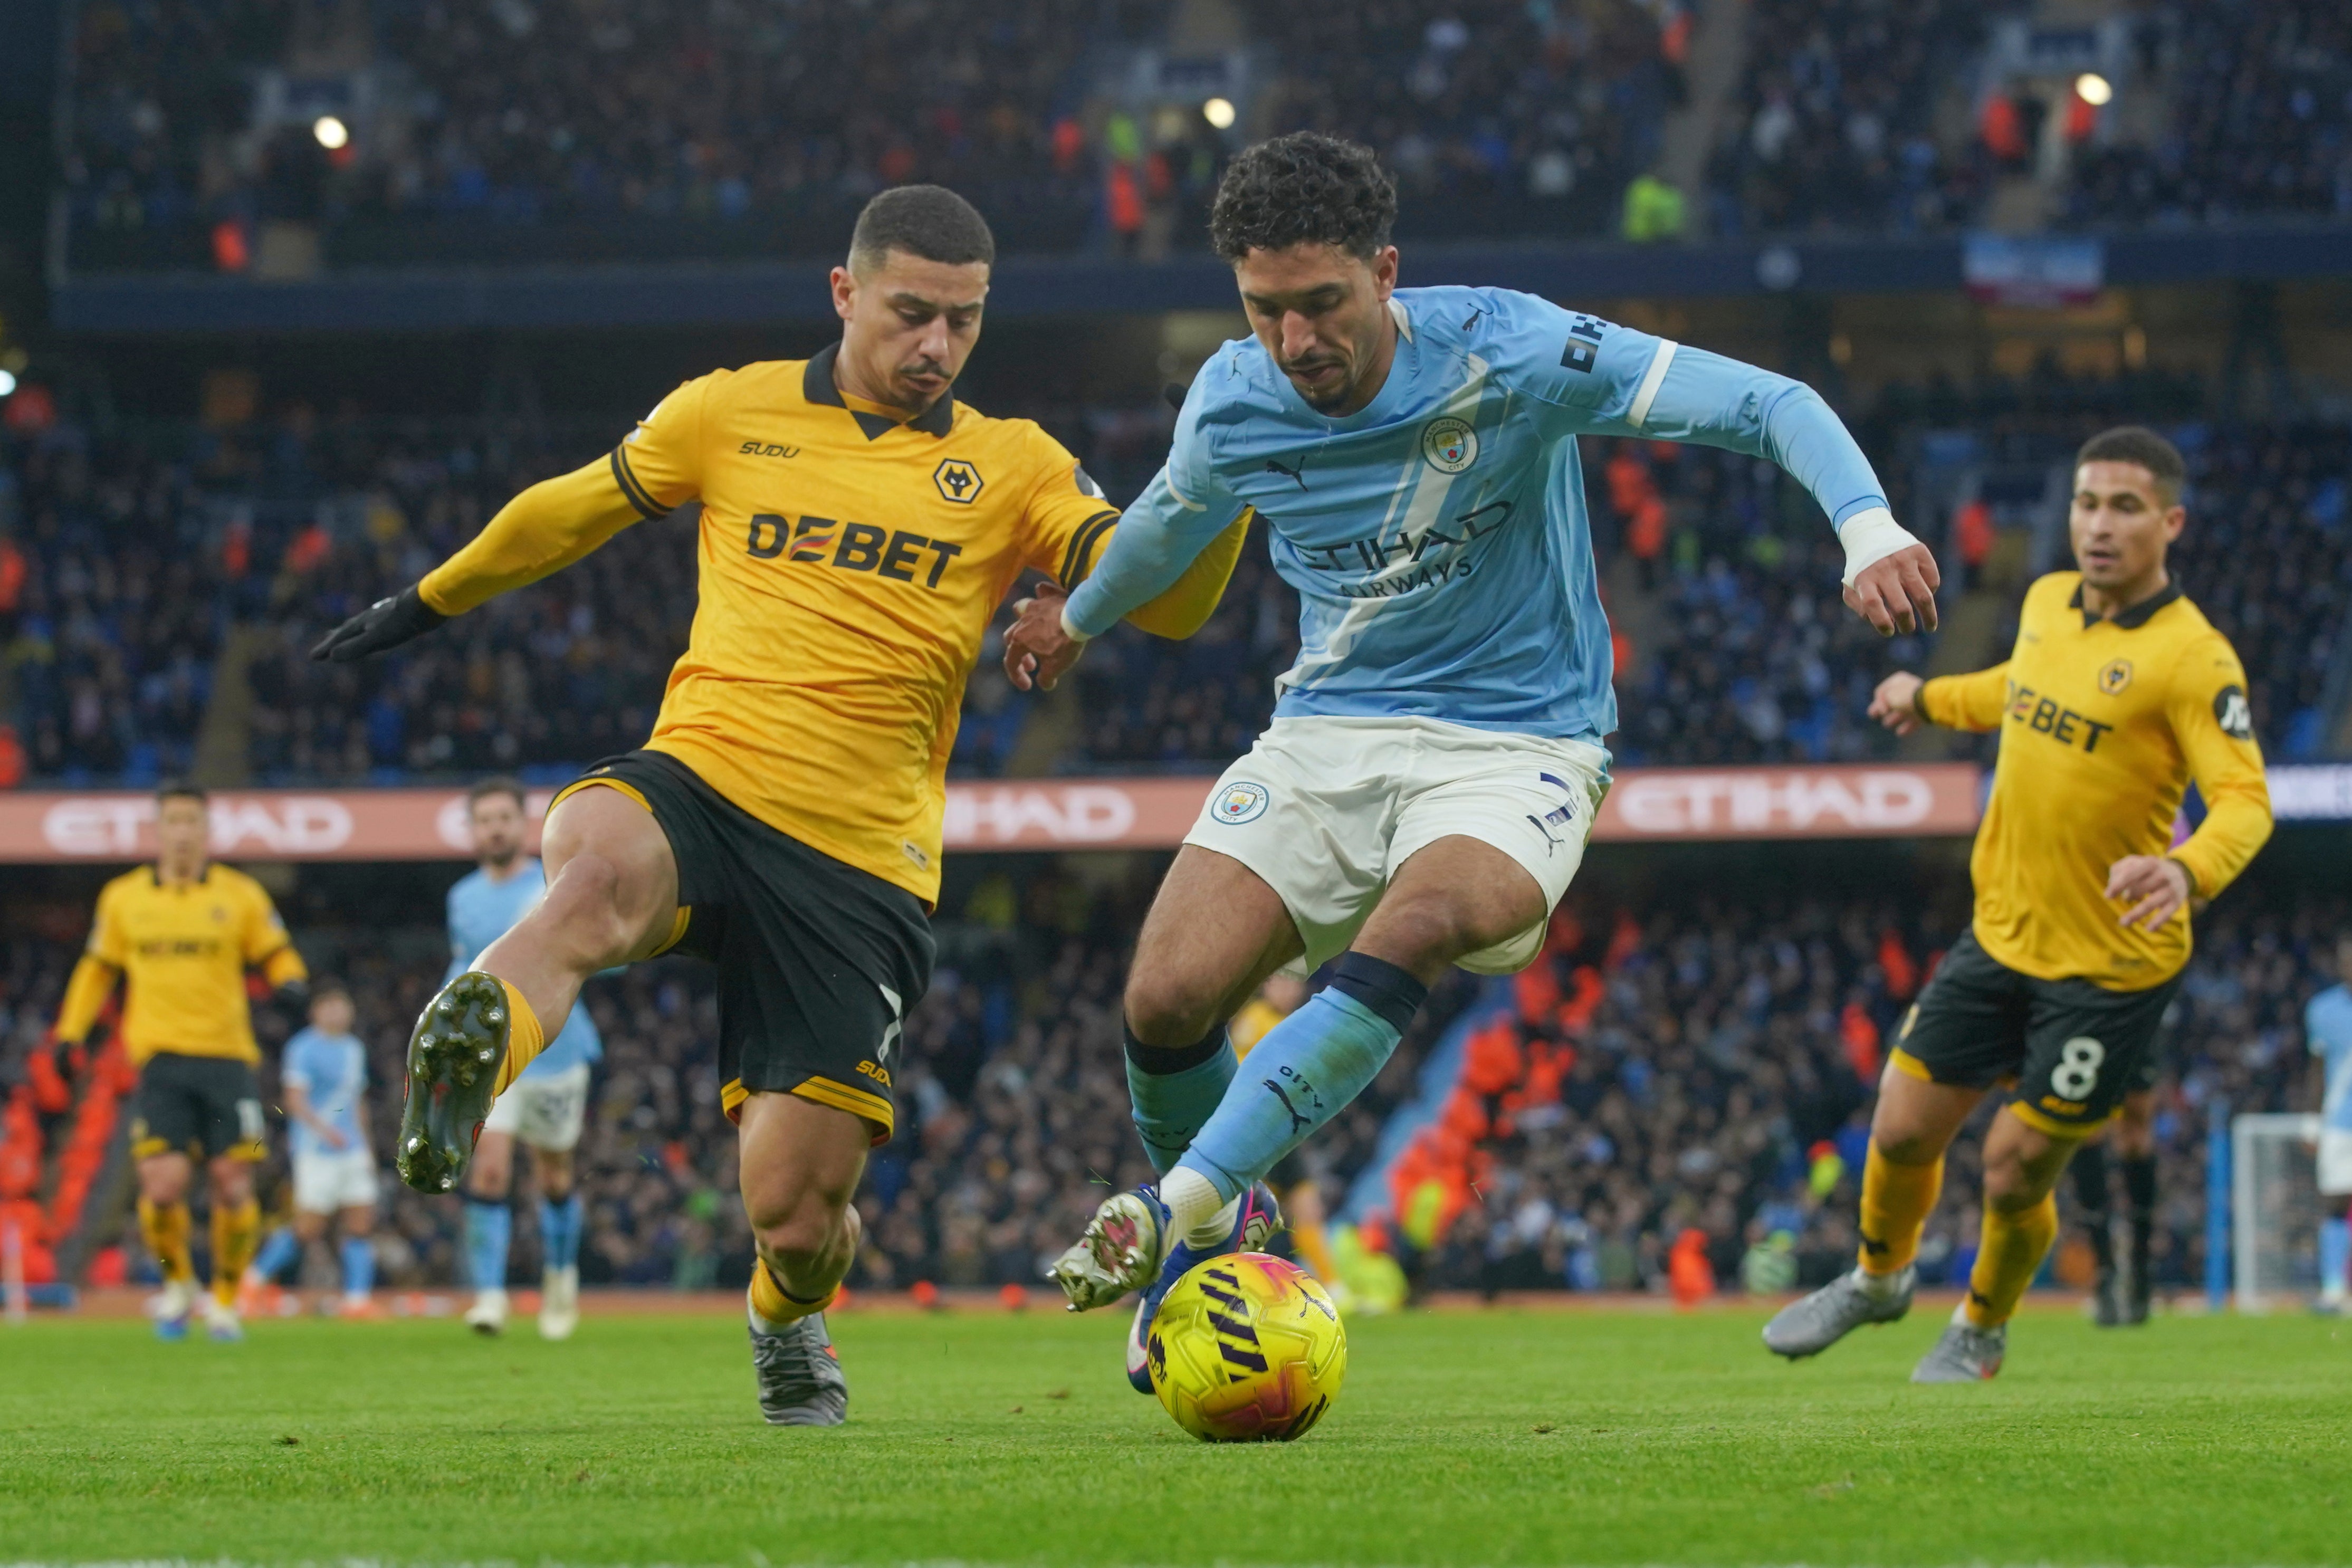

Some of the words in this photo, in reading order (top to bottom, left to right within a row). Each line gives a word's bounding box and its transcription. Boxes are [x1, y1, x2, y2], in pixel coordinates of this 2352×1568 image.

[739, 442, 800, 458] SUDU
[1449, 462, 1464, 471] CITY
[747, 513, 962, 589] DEBET
[1340, 556, 1473, 597] AIRWAYS
[1224, 785, 1264, 801] MANCHESTER
[1618, 771, 1934, 832] ETIHAD
[2051, 1037, 2105, 1101] 8
